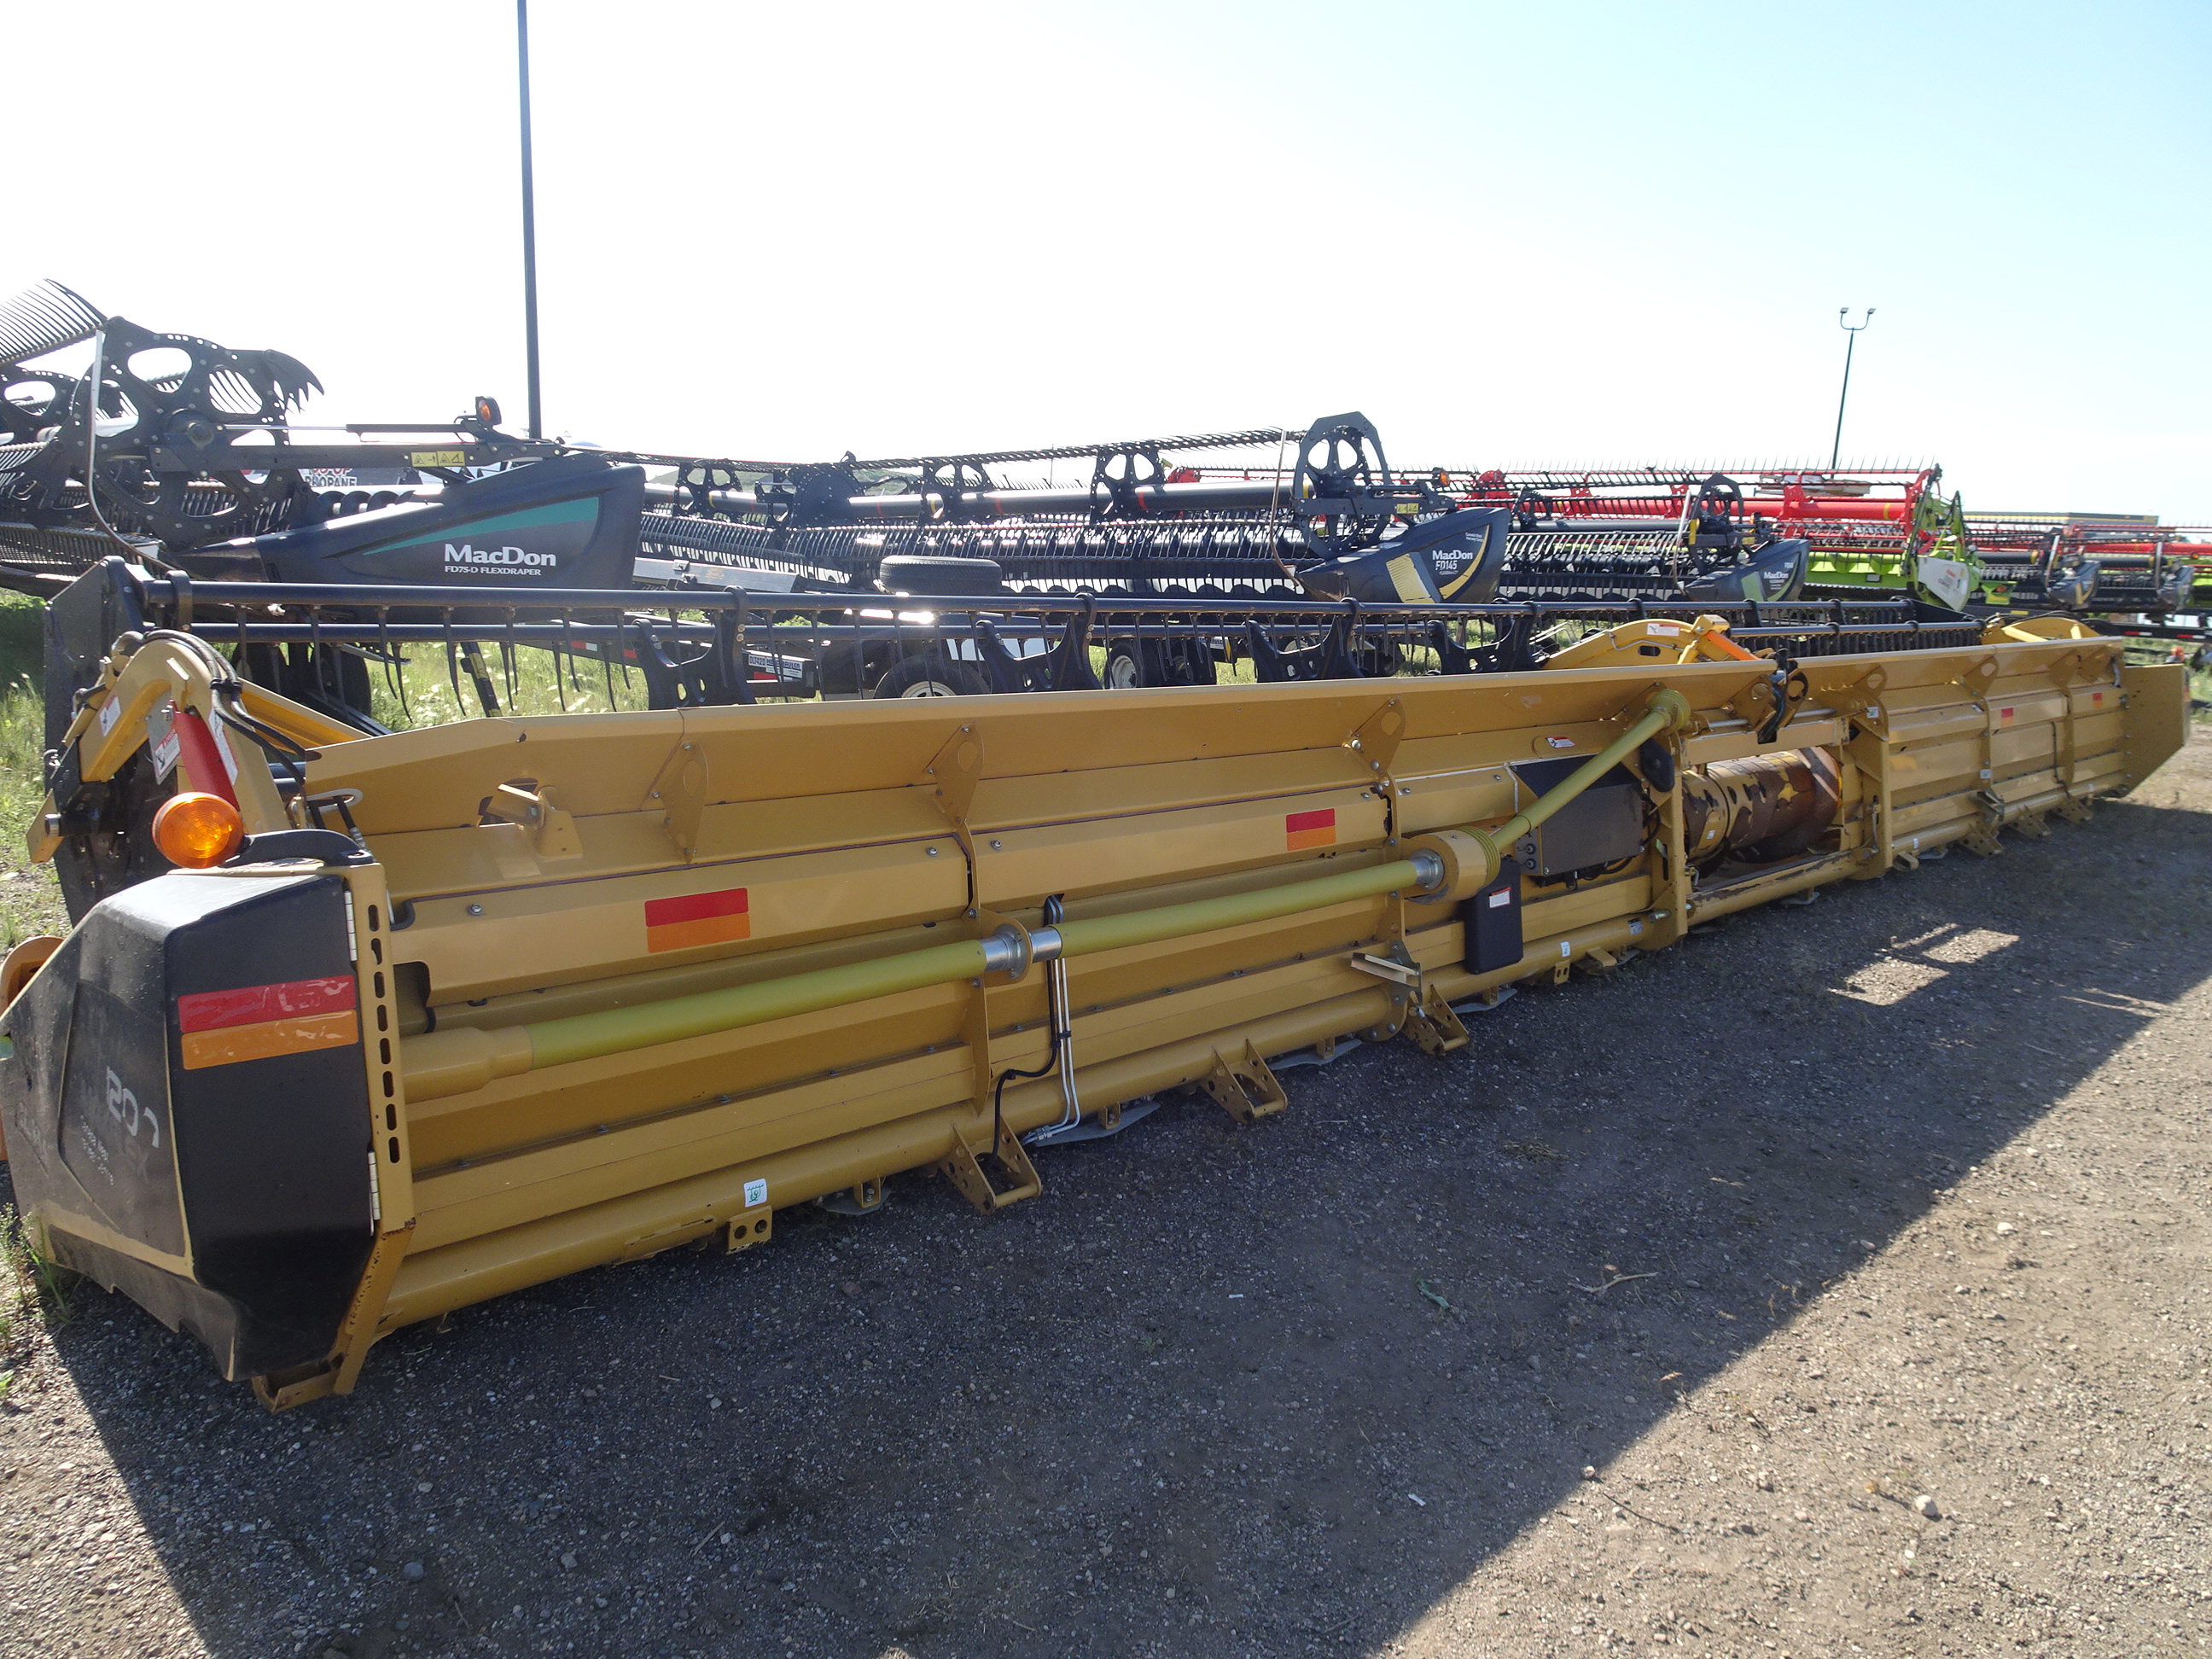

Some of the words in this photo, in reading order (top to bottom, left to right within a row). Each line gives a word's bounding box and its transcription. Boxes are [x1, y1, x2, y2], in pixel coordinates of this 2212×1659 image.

[445, 544, 556, 566] MacDon
[1432, 550, 1473, 560] MacDon
[480, 567, 541, 576] FLEXDRAPER
